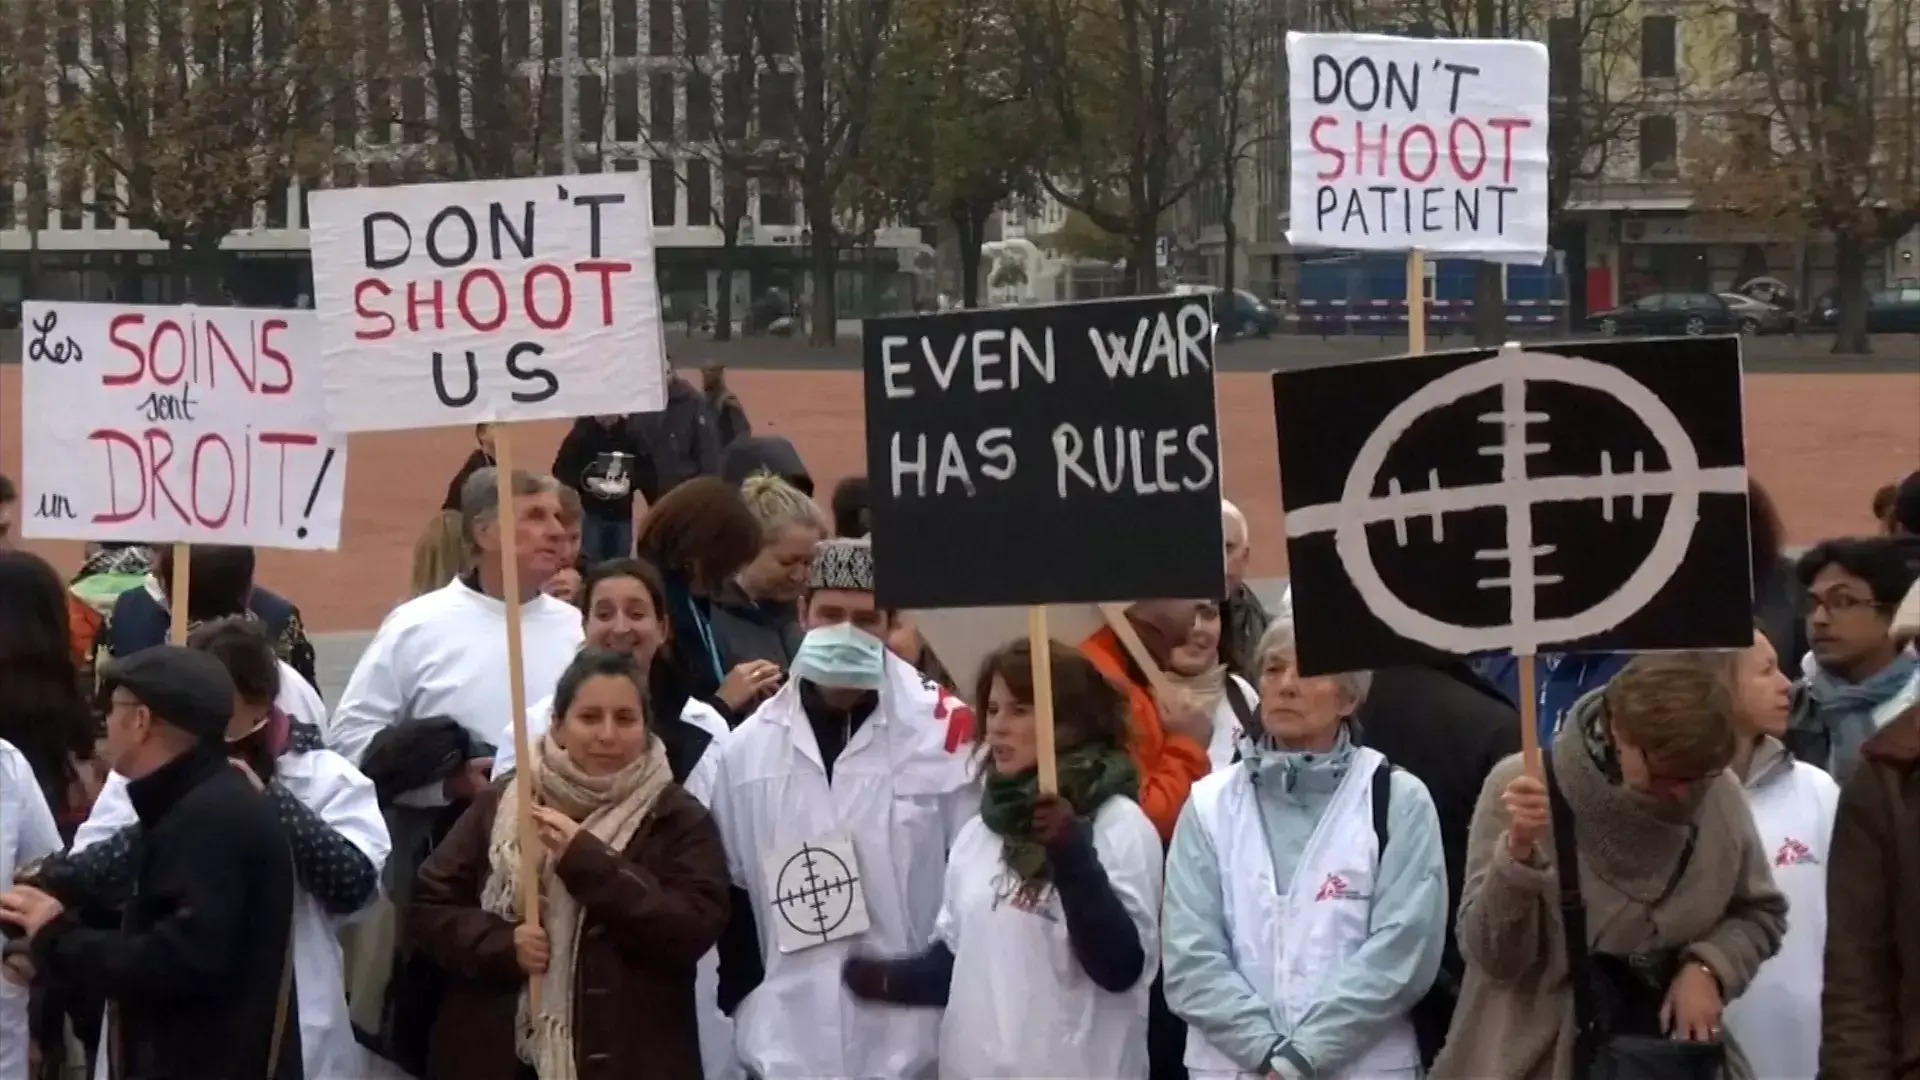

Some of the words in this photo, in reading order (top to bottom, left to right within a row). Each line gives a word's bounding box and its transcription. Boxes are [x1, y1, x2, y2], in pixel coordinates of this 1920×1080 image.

[1313, 54, 1479, 114] DON'T
[1310, 115, 1531, 183] SHOOT
[363, 184, 625, 269] DON'T
[1317, 185, 1518, 235] PATIENT
[354, 262, 632, 340] SHOOT
[29, 310, 83, 363] Les
[102, 313, 293, 394] SOINS
[432, 341, 559, 407] US
[882, 326, 1055, 398] EVEN
[1088, 304, 1210, 378] WAR
[136, 381, 198, 421] sont
[35, 493, 77, 519] un
[88, 424, 335, 539] DROIT!
[891, 427, 1017, 497] HAS
[1052, 422, 1214, 498] RULES
